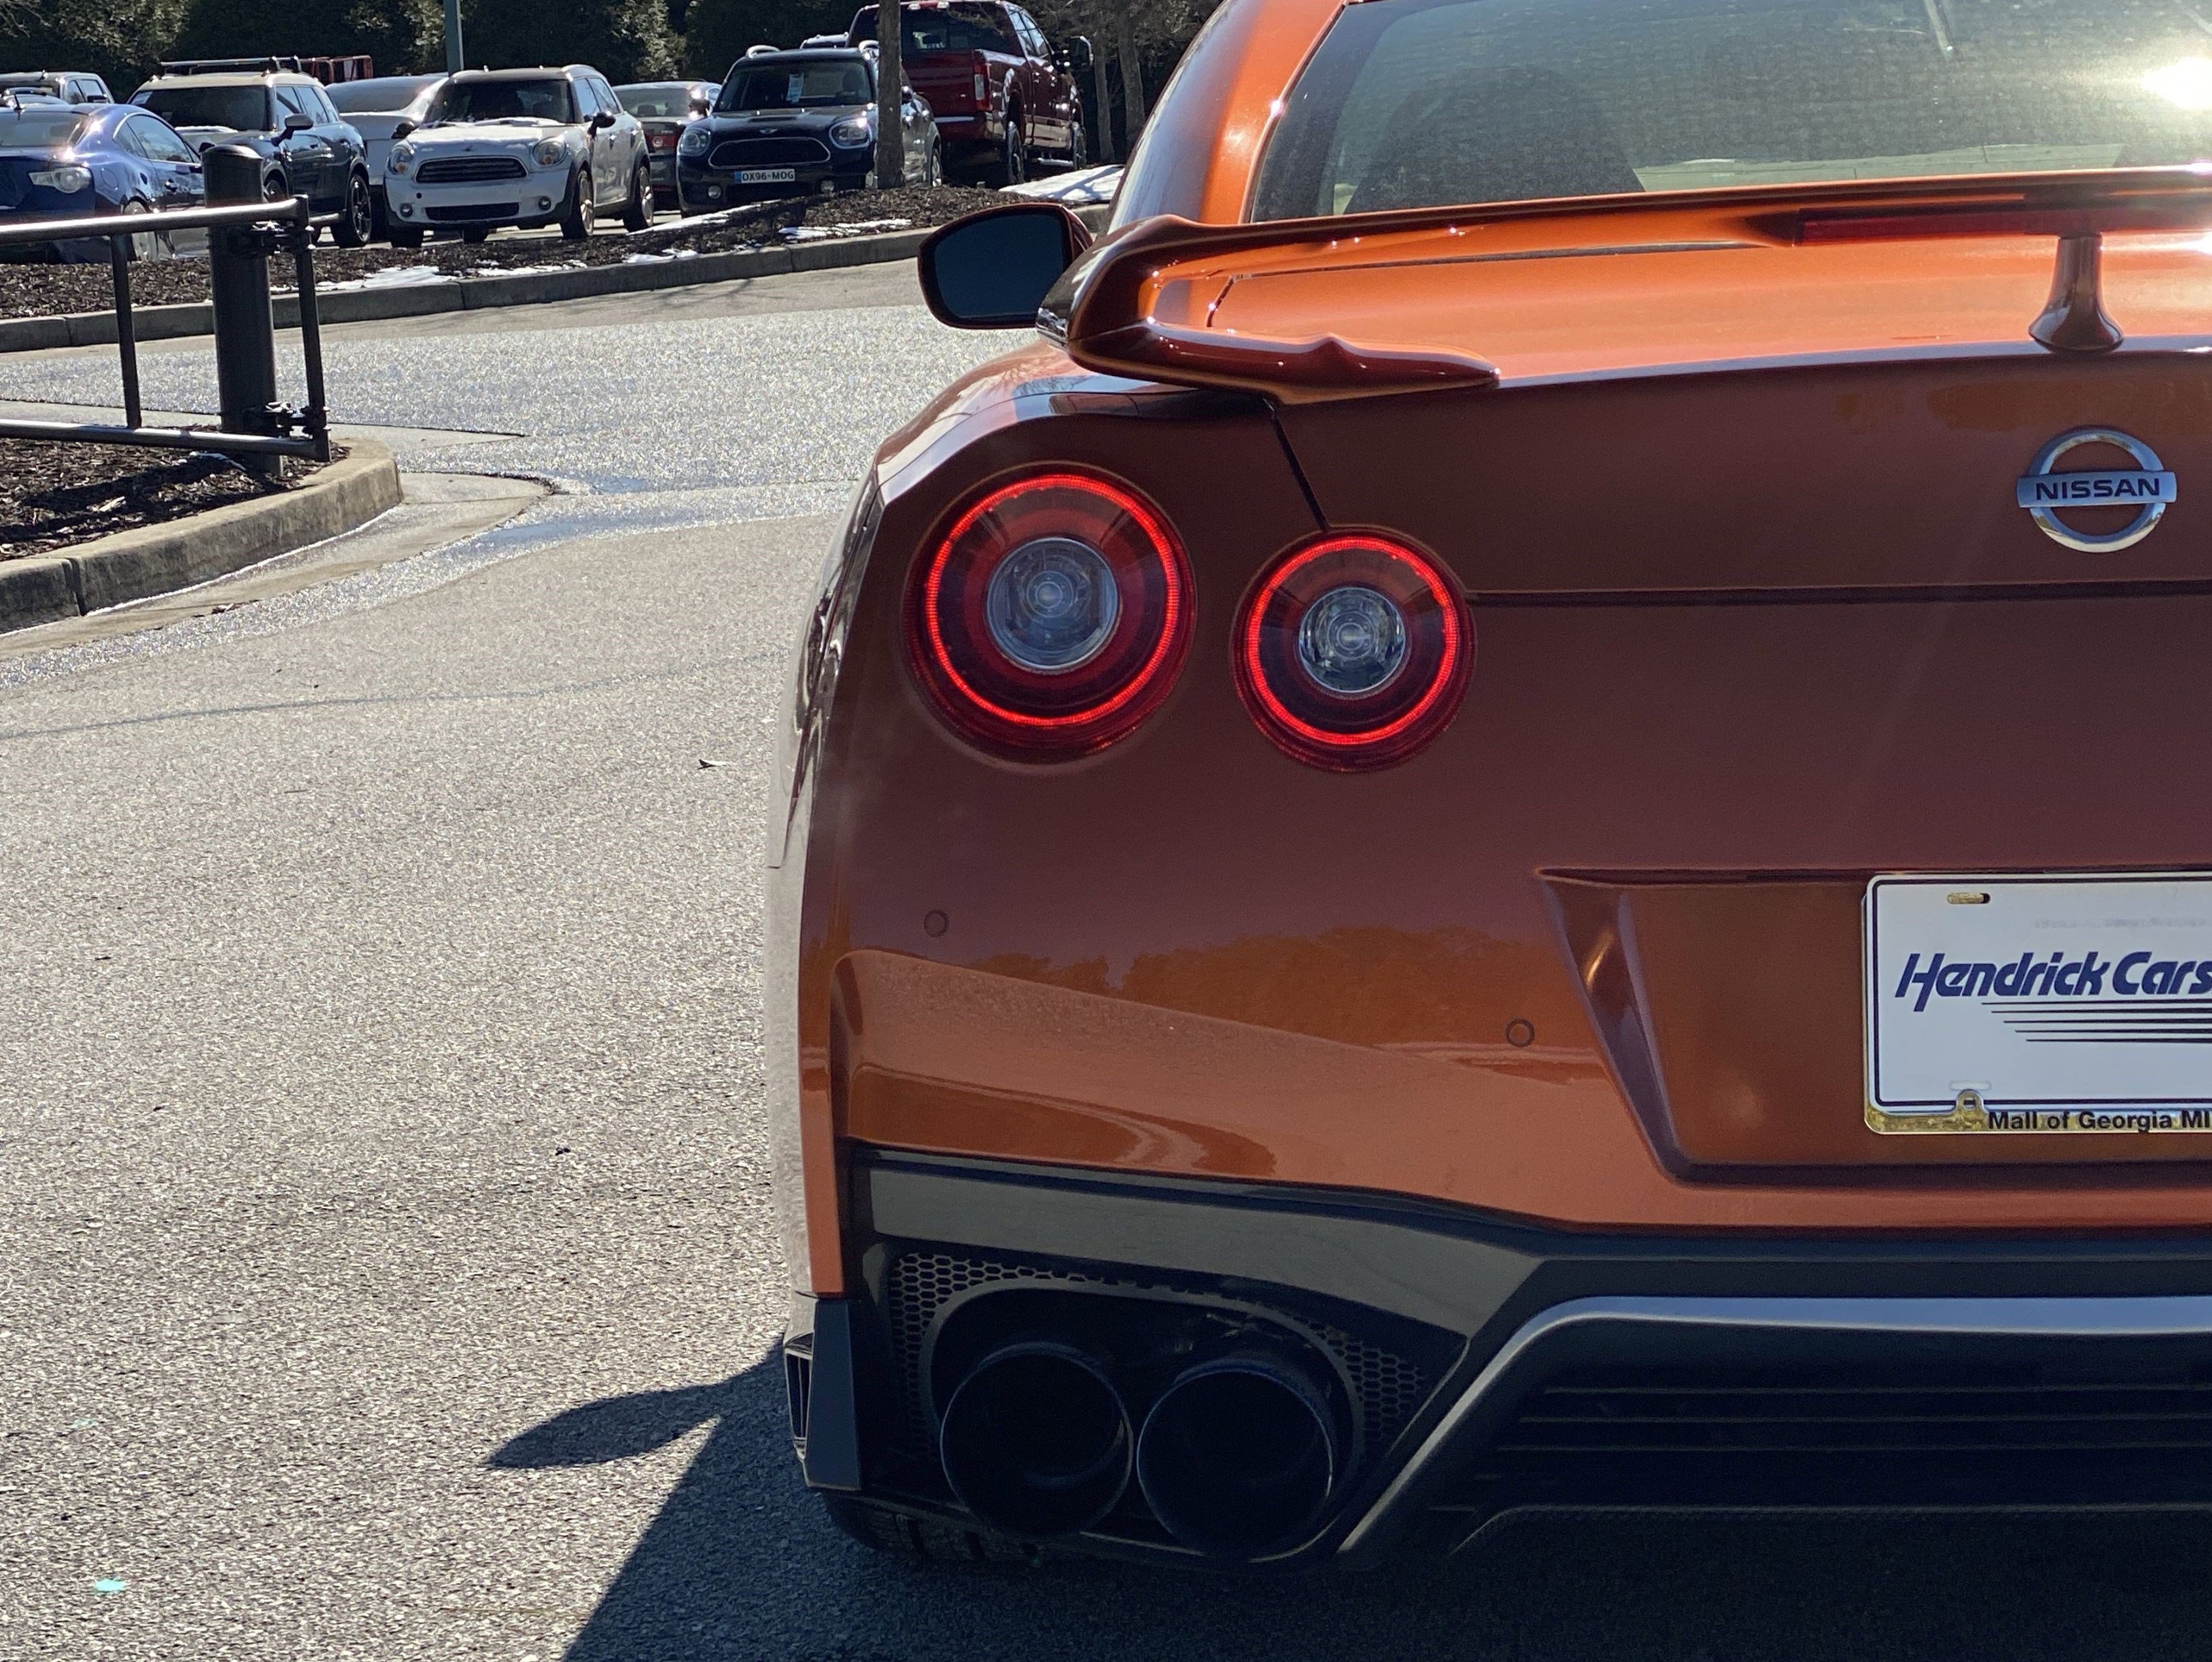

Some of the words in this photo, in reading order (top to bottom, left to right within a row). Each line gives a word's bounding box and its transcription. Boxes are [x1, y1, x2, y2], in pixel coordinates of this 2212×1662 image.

[2035, 477, 2160, 500] NISSAN
[1895, 952, 2110, 1012] Hendrick
[1988, 1111, 2037, 1130] Mall
[2047, 1111, 2071, 1130] of
[2078, 1111, 2173, 1133] Georgia
